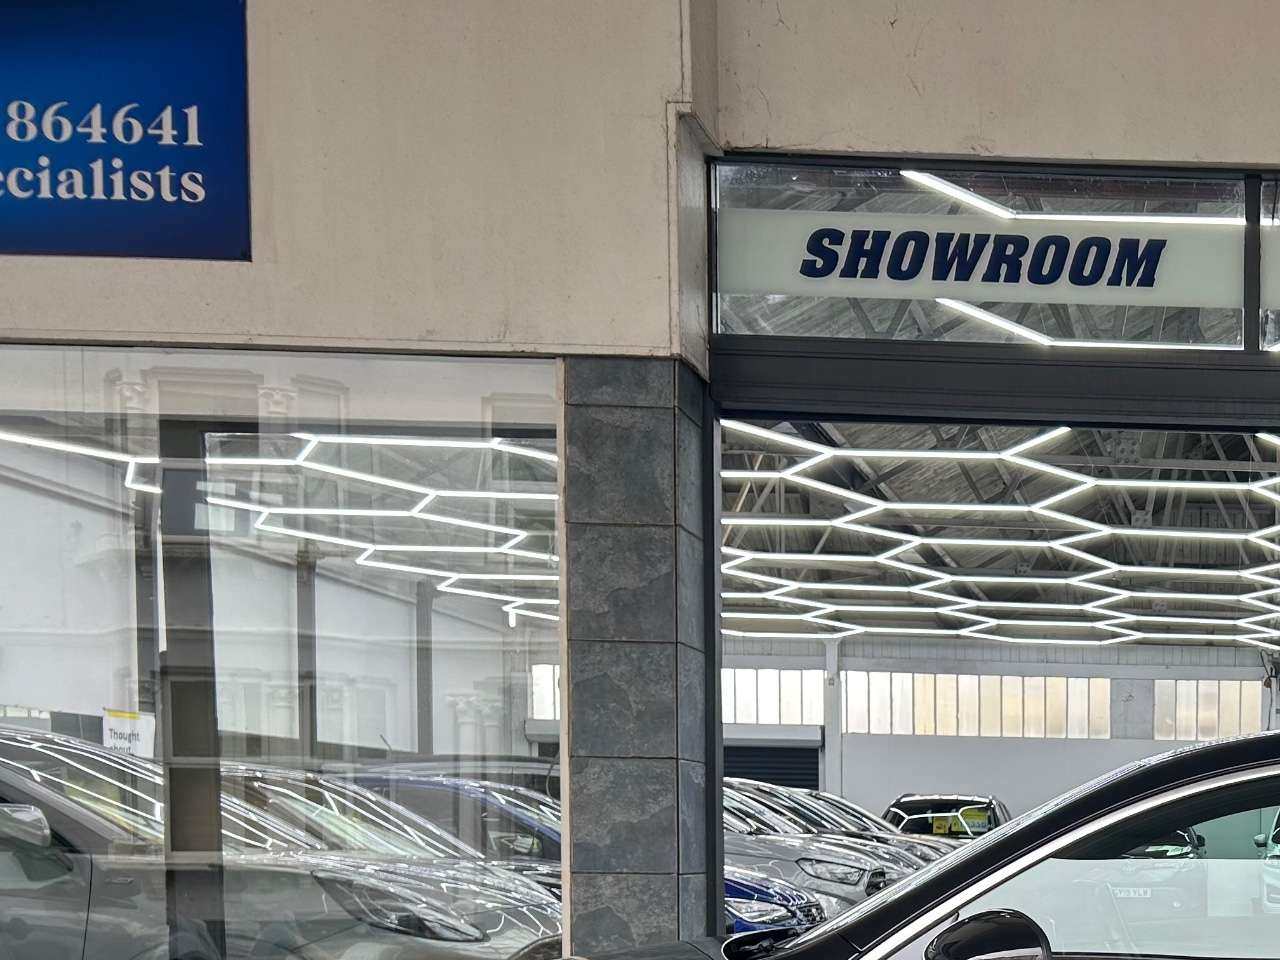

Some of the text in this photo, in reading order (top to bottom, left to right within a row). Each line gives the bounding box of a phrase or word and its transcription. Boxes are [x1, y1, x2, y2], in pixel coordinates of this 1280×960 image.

[6, 100, 204, 146] 864641
[0, 155, 206, 203] cialists
[799, 228, 1167, 288] SHOWROOM
[108, 728, 141, 744] Thought
